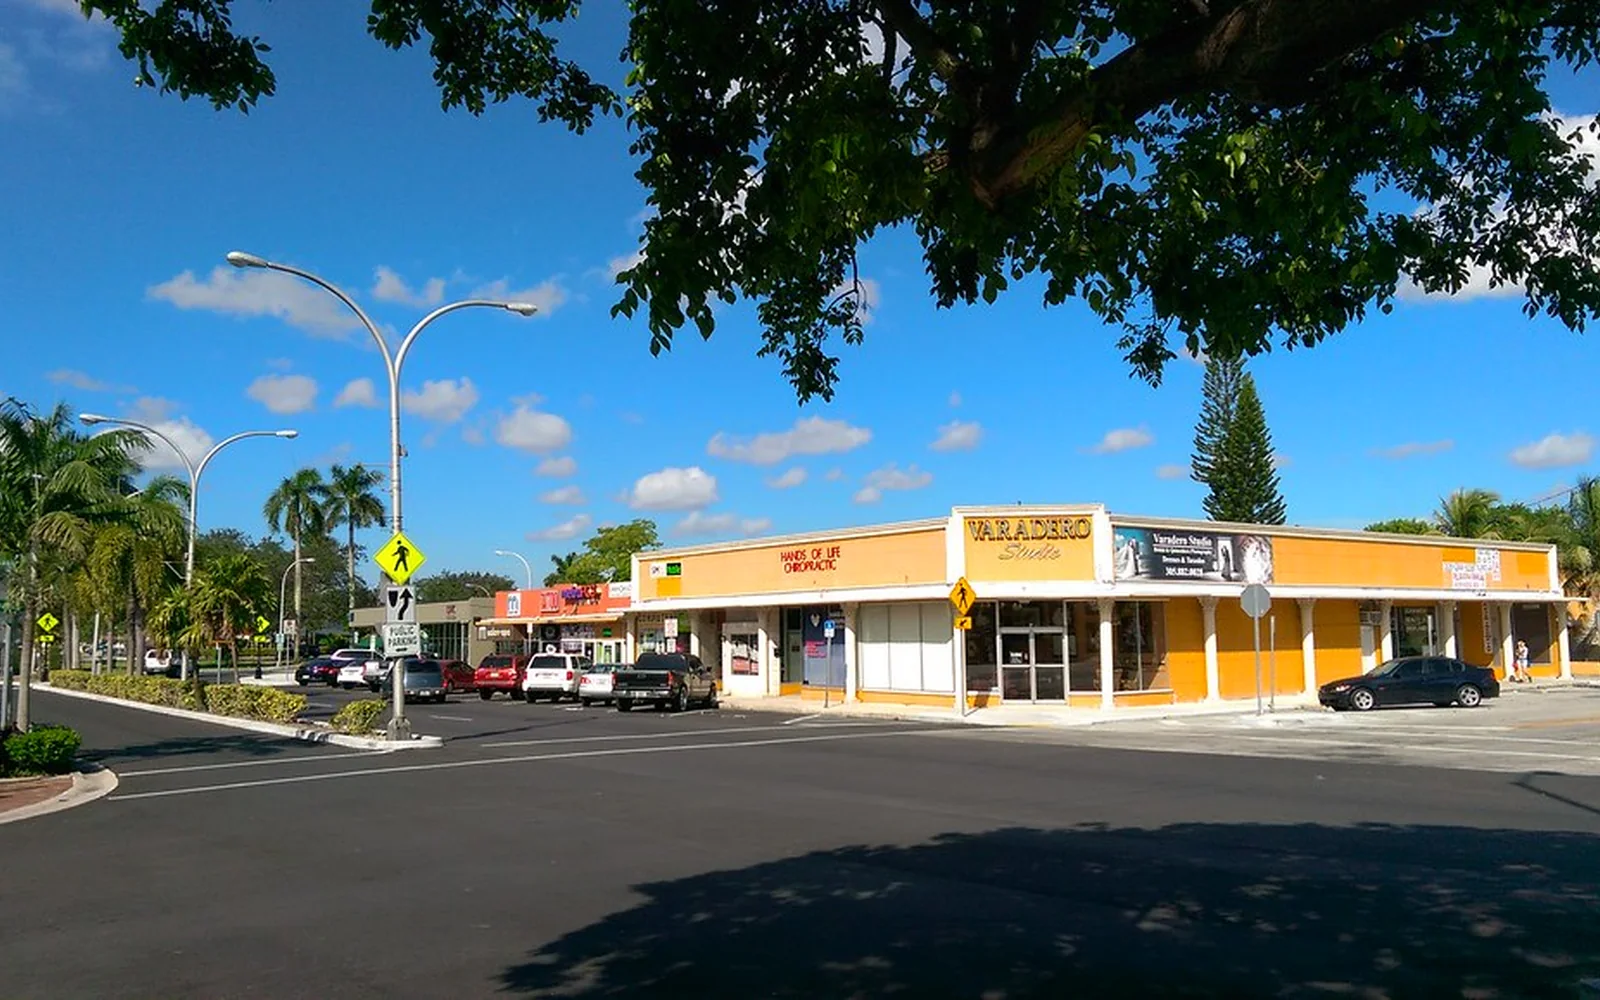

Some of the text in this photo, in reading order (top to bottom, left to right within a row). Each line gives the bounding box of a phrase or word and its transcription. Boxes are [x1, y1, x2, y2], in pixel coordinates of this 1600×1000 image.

[968, 518, 1092, 541] VARADERO
[1153, 533, 1213, 547] Varadero Studio
[780, 546, 841, 562] HANDS OF LIFE
[998, 543, 1061, 561] Studio
[784, 559, 837, 574] CHIROPRACTIC
[390, 625, 415, 636] PUBLIC
[388, 635, 418, 647] PARKING
